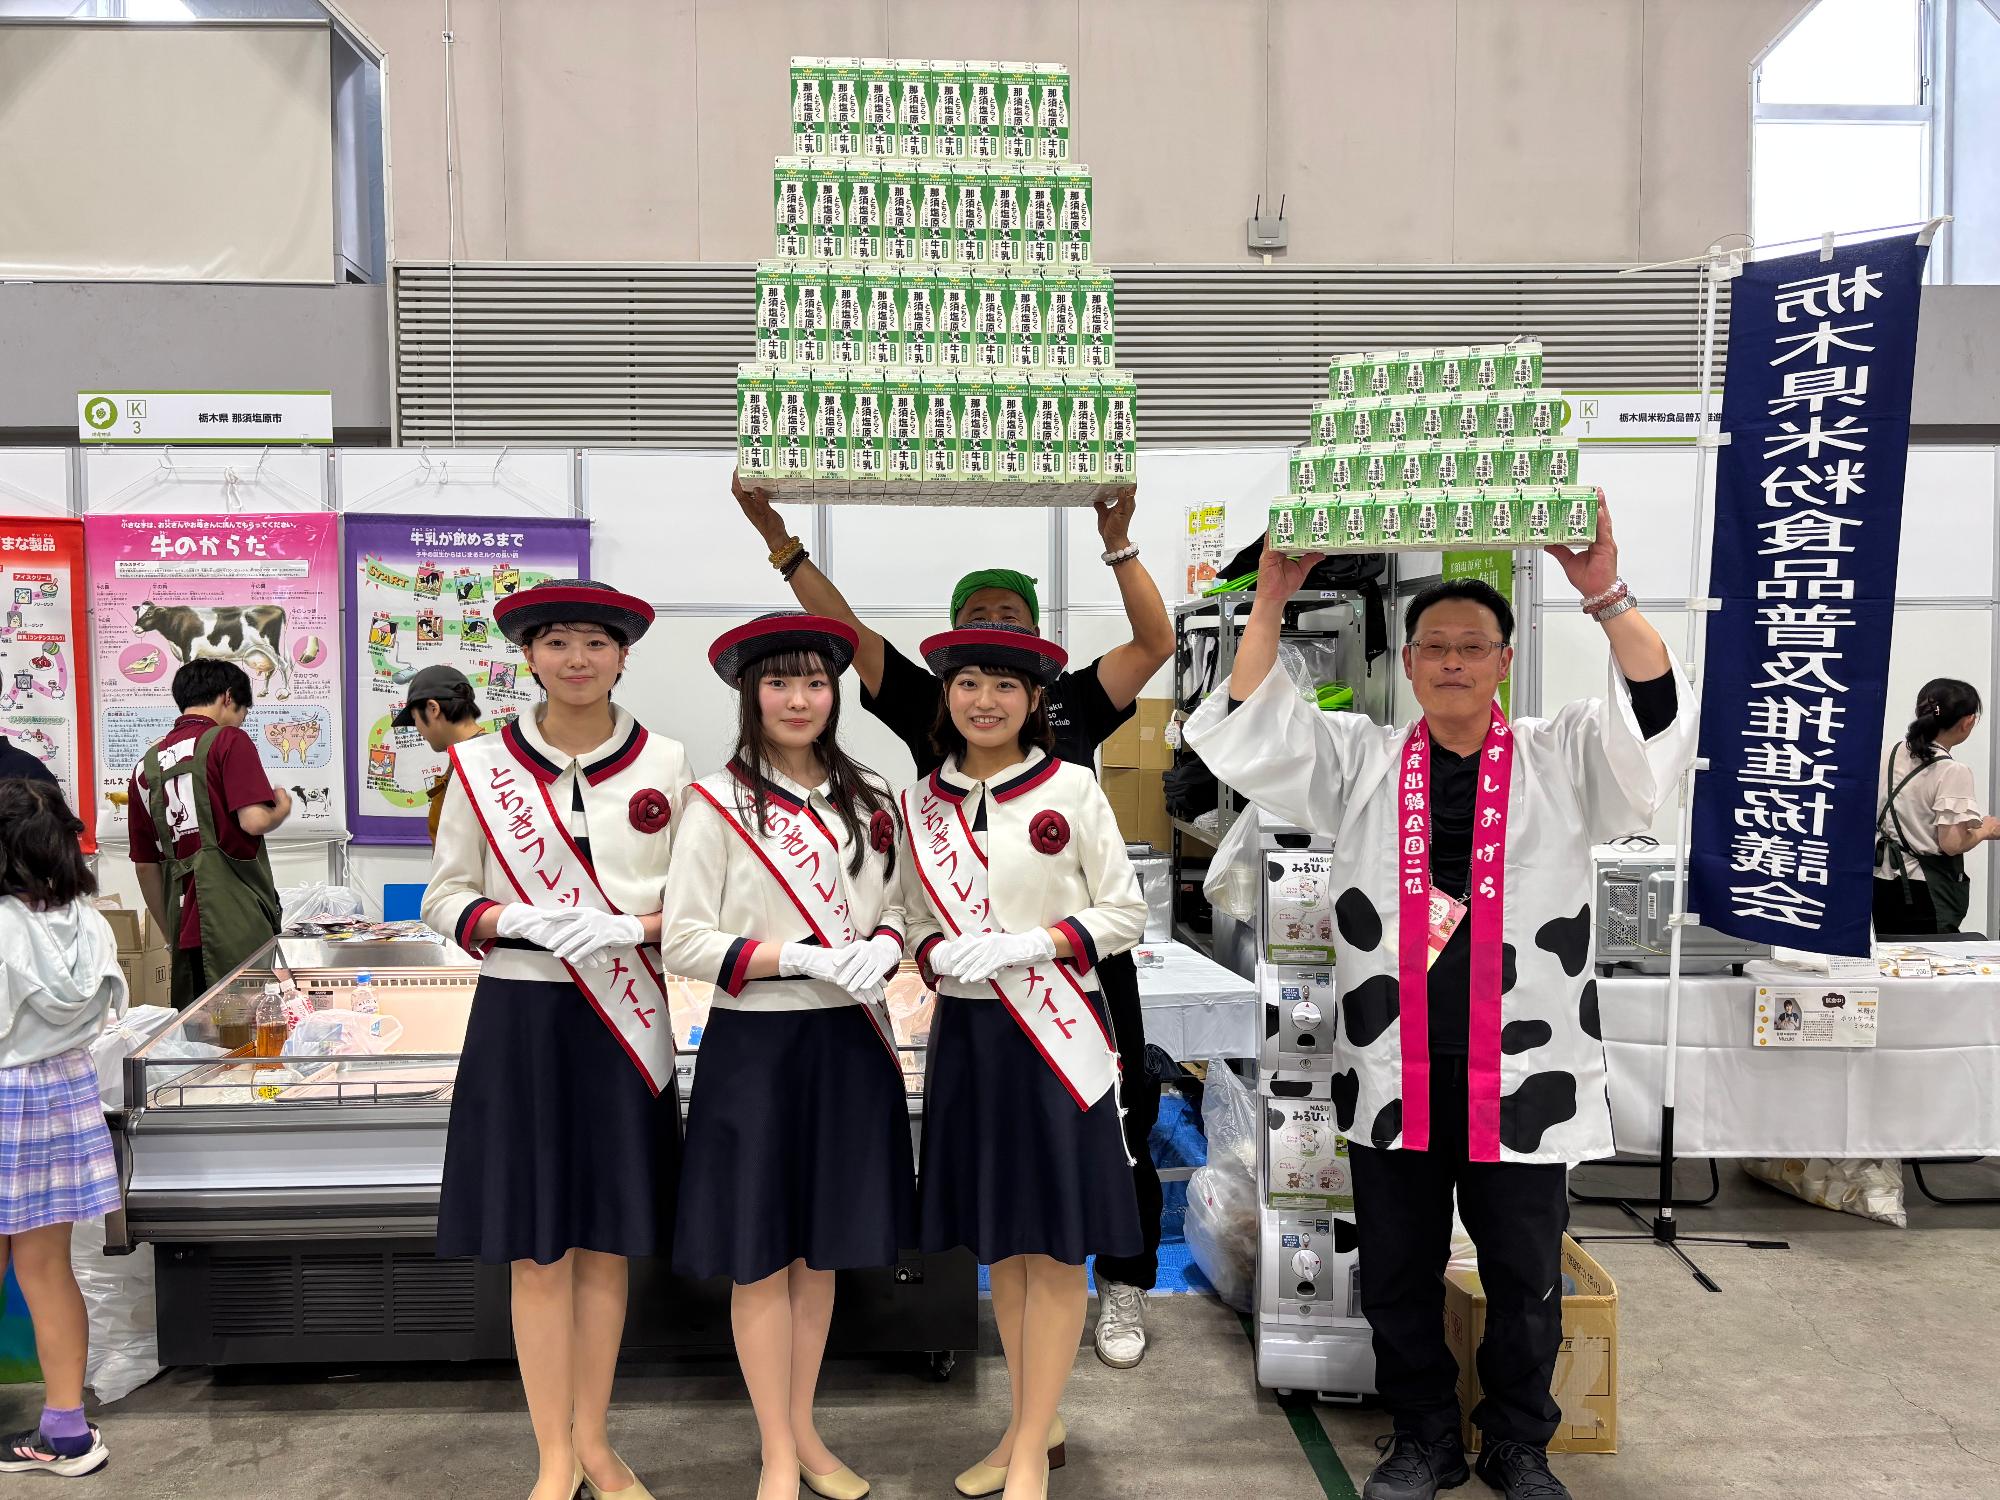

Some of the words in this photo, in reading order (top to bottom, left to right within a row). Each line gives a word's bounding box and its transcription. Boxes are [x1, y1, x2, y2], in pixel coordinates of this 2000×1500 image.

[131, 402, 142, 416] K
[1584, 402, 1594, 416] K
[198, 412, 229, 423] 栃木県
[231, 412, 282, 423] 那須塩原市
[132, 420, 142, 434] 3
[150, 534, 267, 558] 牛のからだ
[410, 532, 524, 547] 牛乳が飲めるまで
[368, 564, 410, 588] START
[1054, 718, 1071, 726] club
[1476, 721, 1508, 899] なすしおばら
